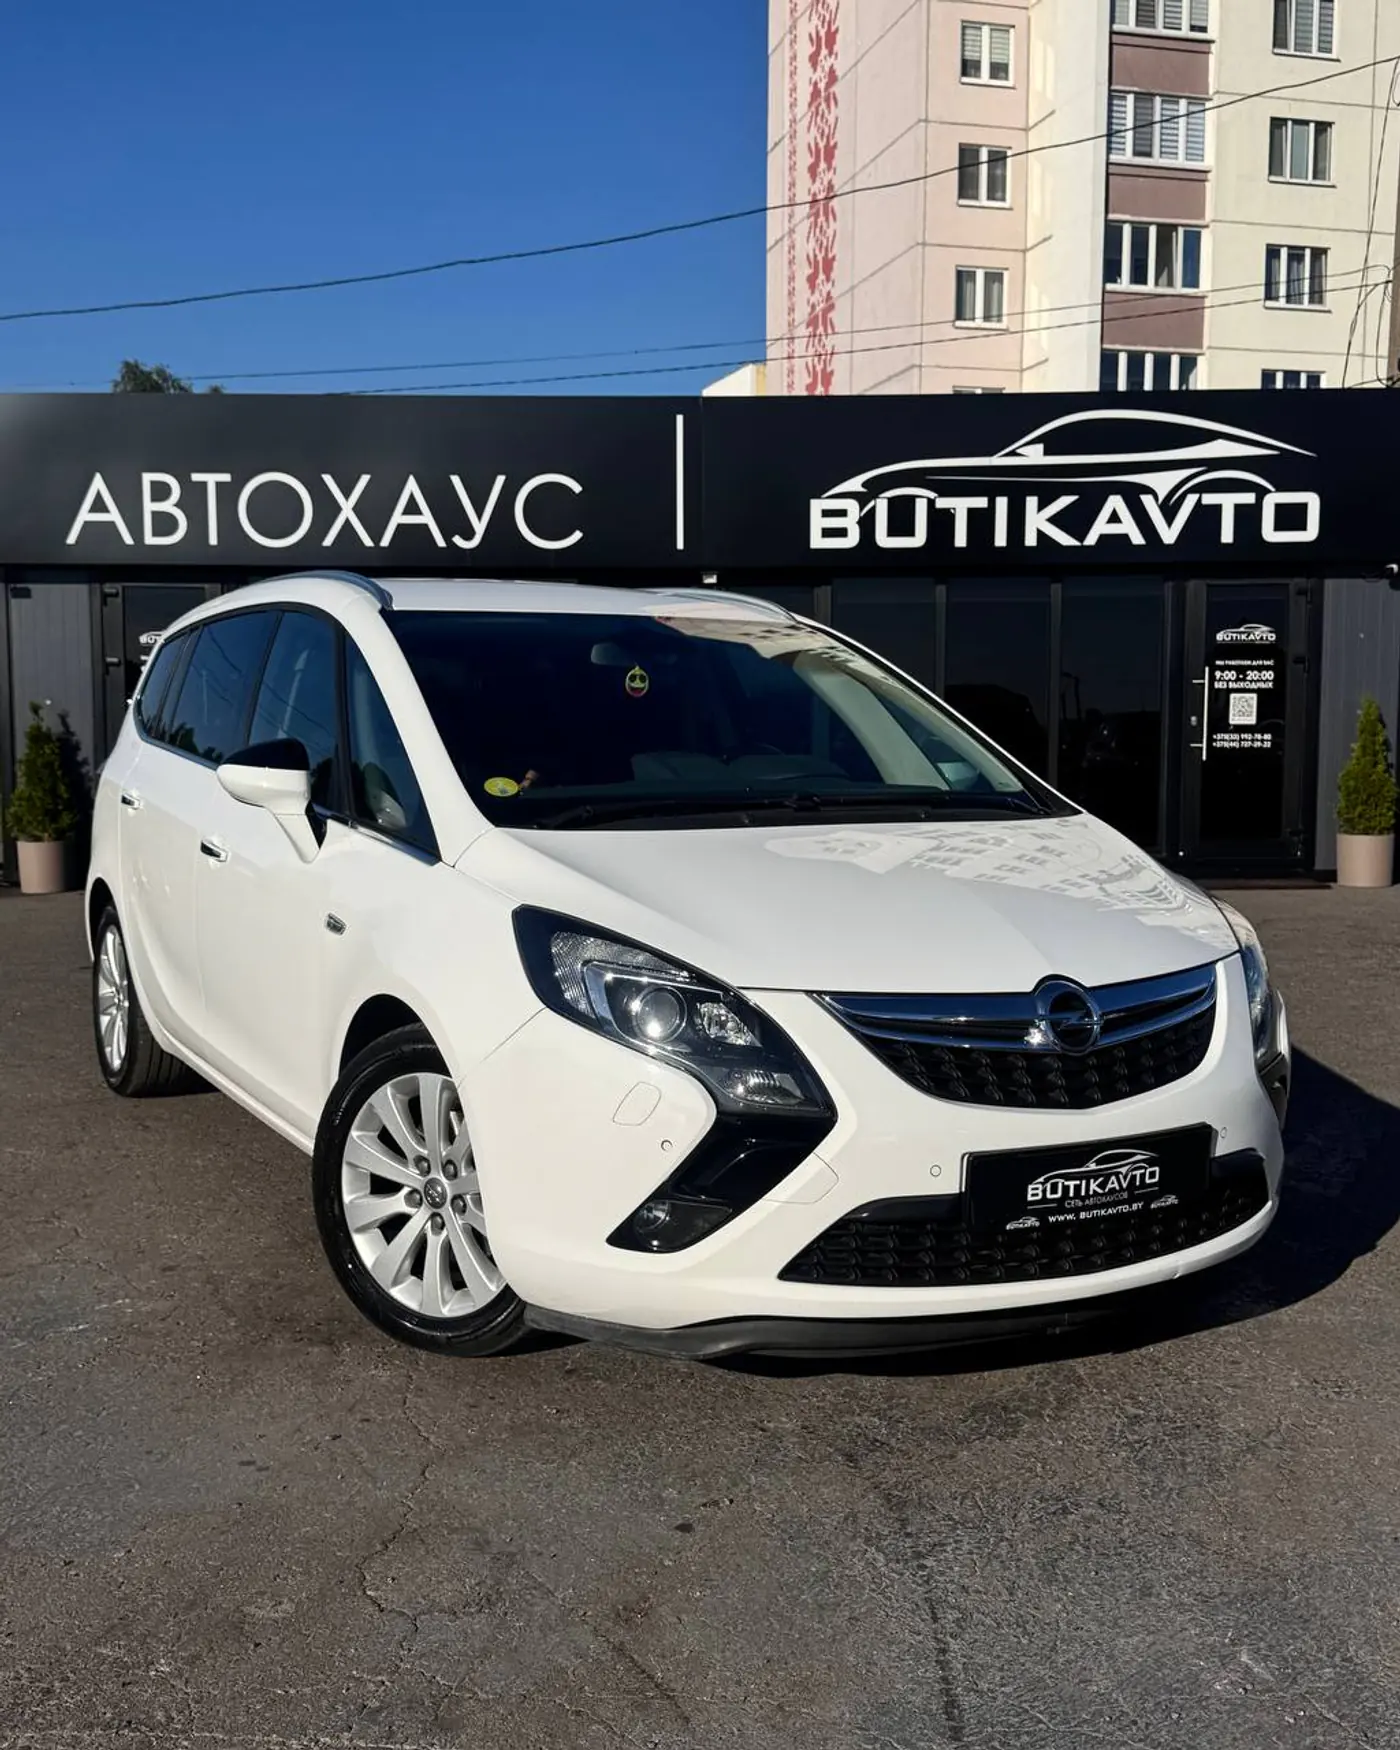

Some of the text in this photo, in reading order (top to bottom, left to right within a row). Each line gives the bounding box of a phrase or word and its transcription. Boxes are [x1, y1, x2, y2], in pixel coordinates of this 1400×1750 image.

[65, 471, 585, 550] АВТОХАУС
[810, 491, 1321, 549] BUTIKAVTO
[1216, 633, 1276, 641] BUTIKAVTO
[1214, 670, 1236, 680] 9:00
[1246, 670, 1274, 680] 20:00
[1027, 1166, 1160, 1202] BUTIKAVTO
